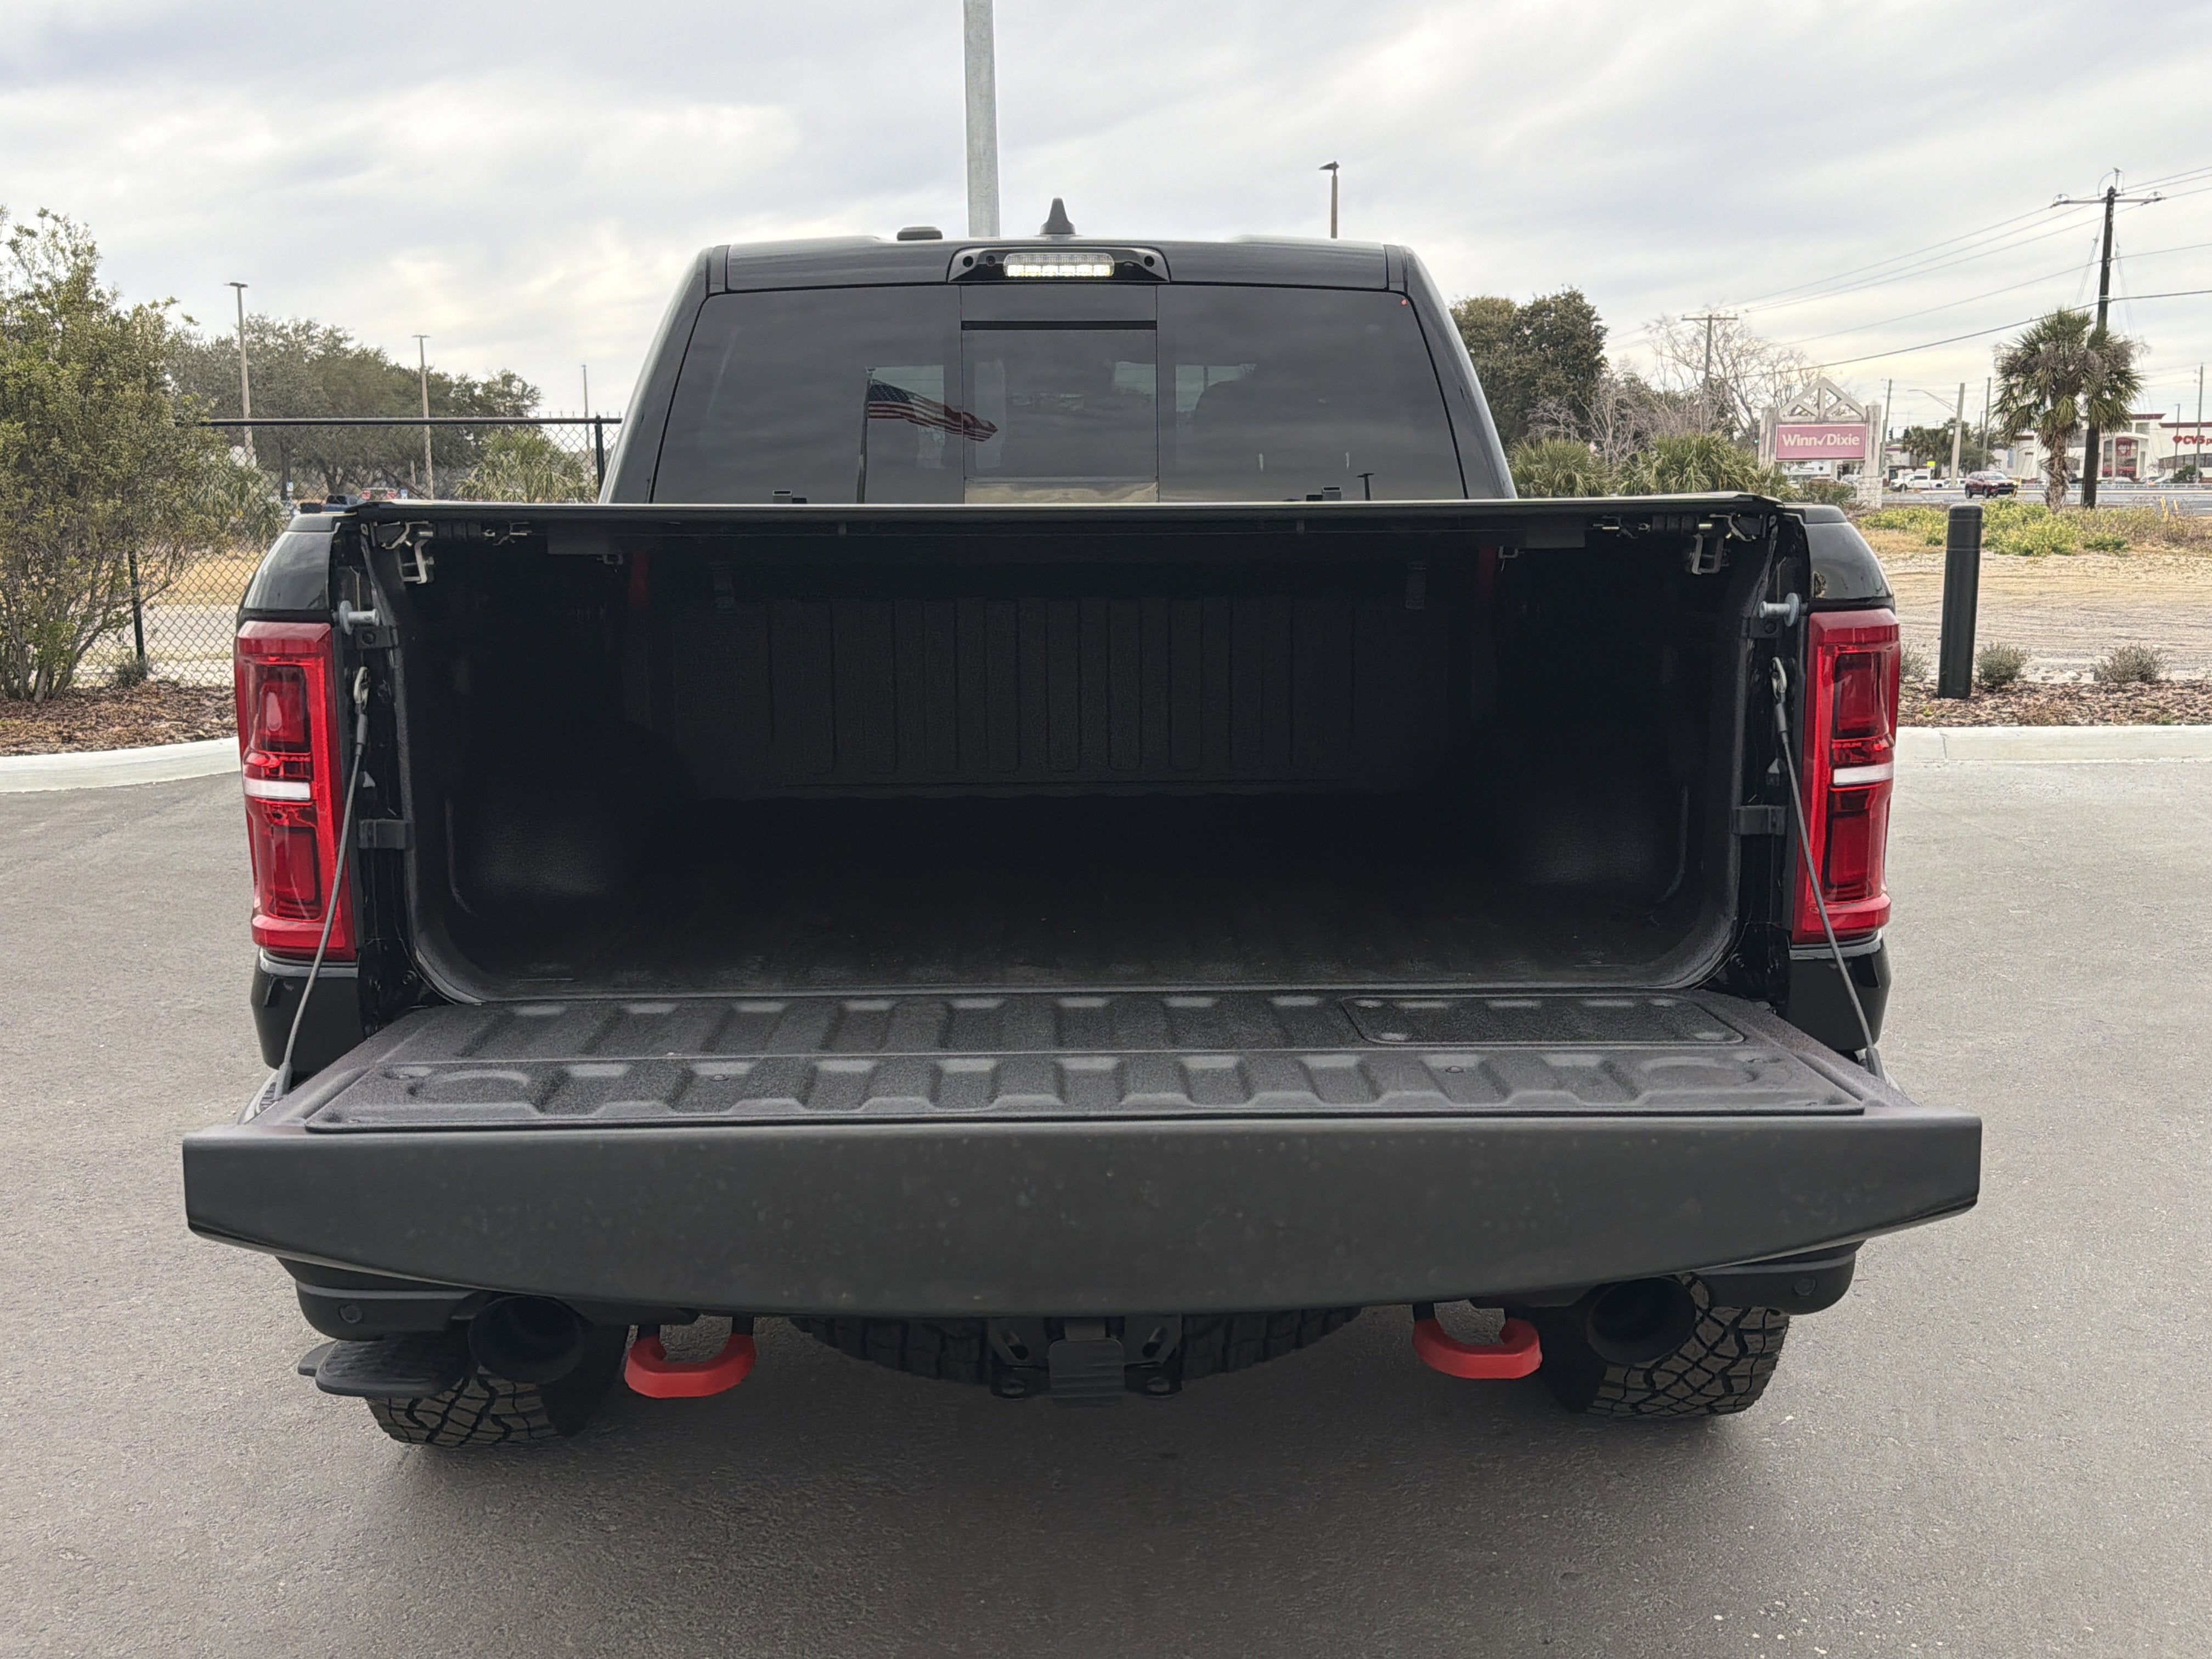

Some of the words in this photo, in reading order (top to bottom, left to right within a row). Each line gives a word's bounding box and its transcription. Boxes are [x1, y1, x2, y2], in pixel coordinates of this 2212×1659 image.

[1782, 433, 1818, 447] Winn
[1827, 433, 1860, 446] Dixie
[2183, 435, 2205, 445] CVS
